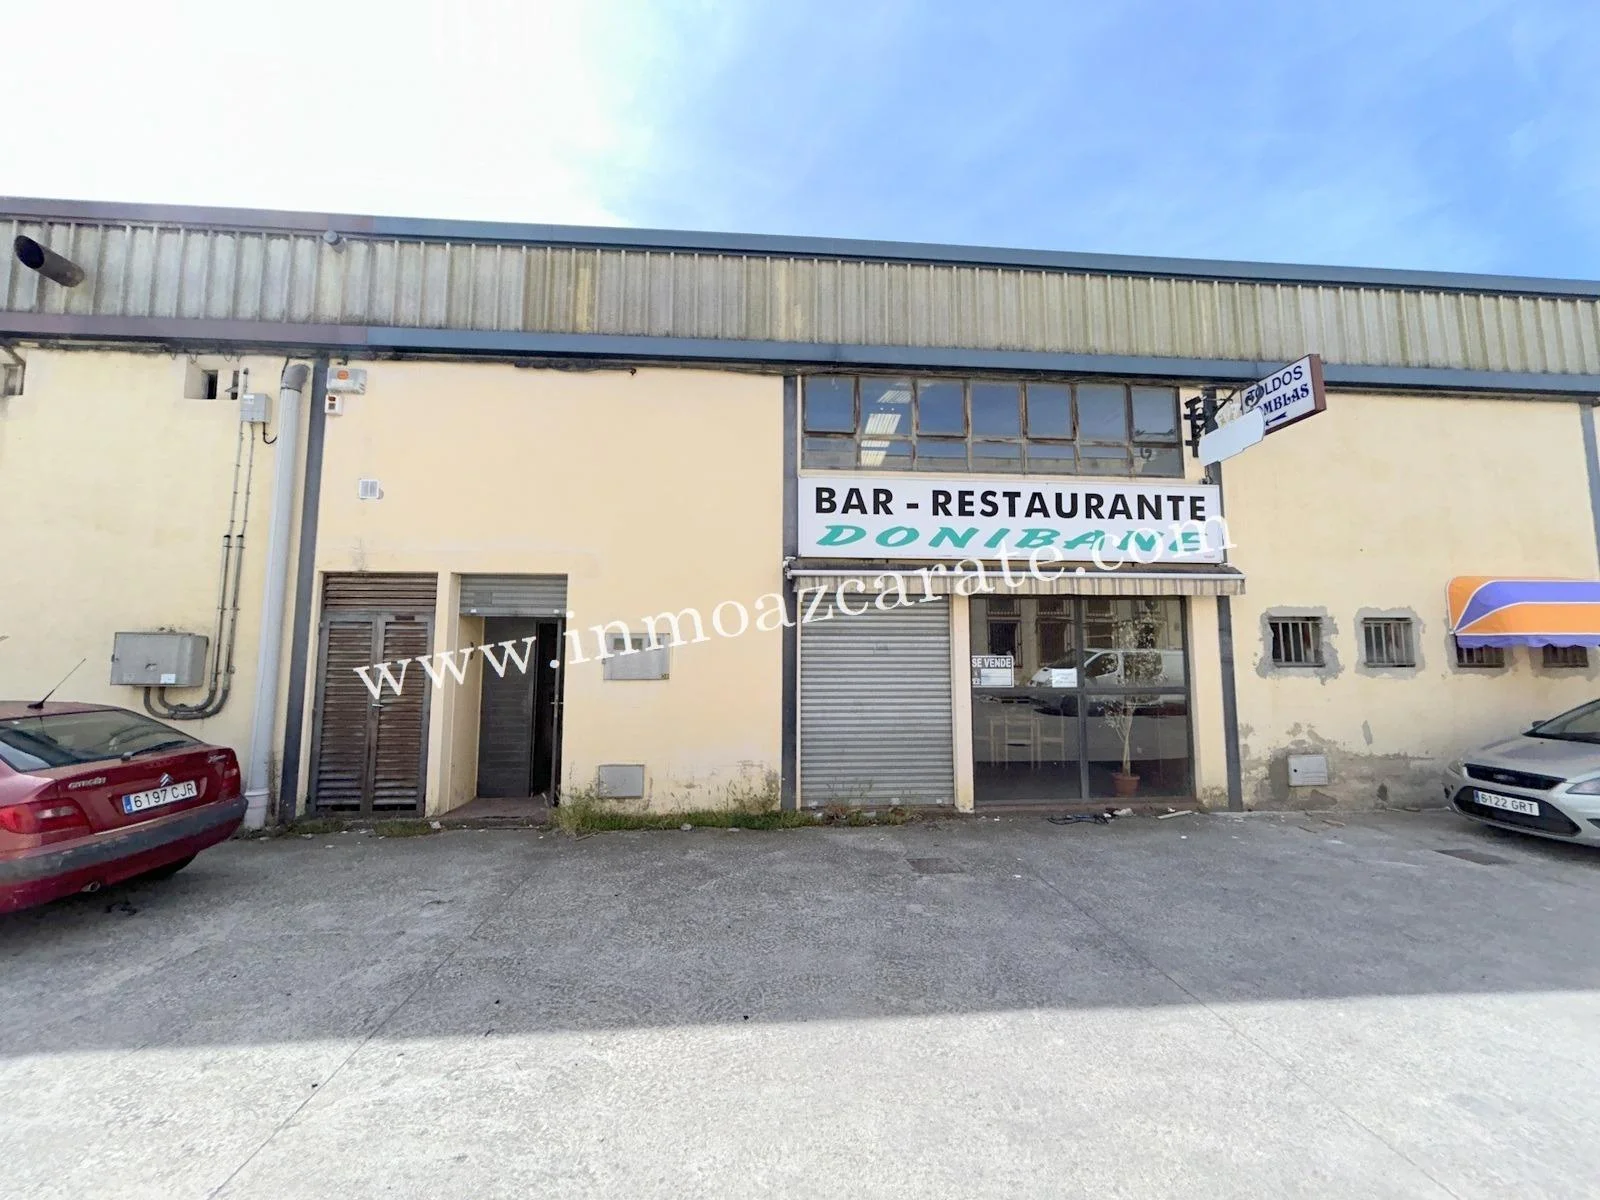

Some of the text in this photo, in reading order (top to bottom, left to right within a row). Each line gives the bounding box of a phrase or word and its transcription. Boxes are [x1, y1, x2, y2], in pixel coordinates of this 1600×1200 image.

[815, 487, 894, 515] BAR
[932, 490, 1206, 521] RESTAURANTE
[972, 658, 1012, 668] SE VENDE
[133, 783, 195, 808] 6197 CJR
[1481, 793, 1534, 813] 6122 GRT
